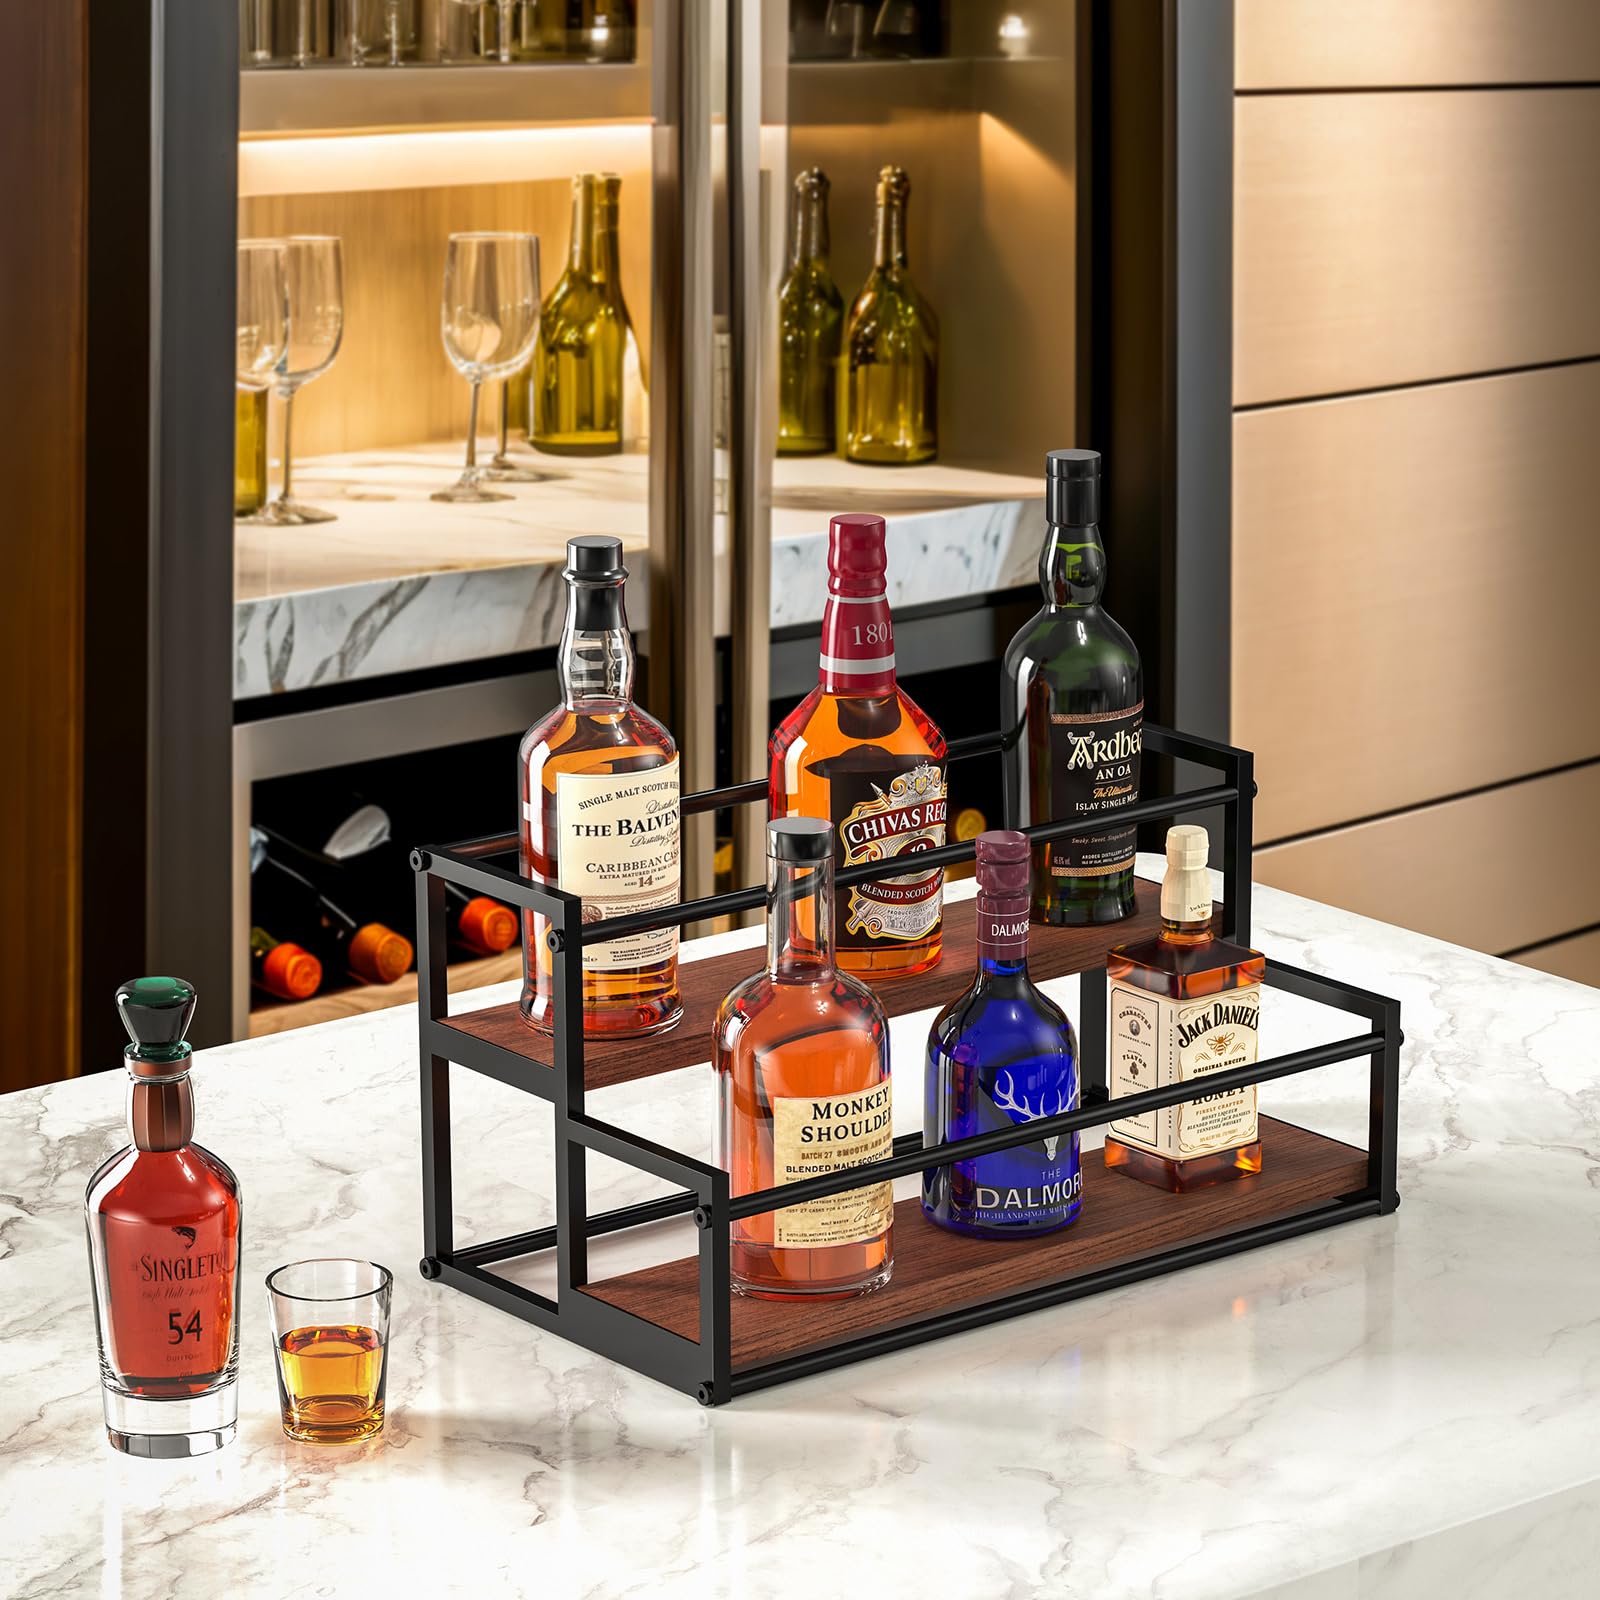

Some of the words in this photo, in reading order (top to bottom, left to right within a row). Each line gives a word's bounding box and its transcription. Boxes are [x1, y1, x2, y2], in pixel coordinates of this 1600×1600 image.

[1096, 767, 1114, 780] AN
[1117, 764, 1132, 777] OA
[578, 793, 613, 811] SINGLE
[615, 786, 640, 800] MALT
[642, 781, 669, 793] SCOTCH
[1076, 802, 1099, 811] ISLAY
[1101, 796, 1127, 809] SINGLE
[572, 824, 611, 837] THE
[848, 808, 921, 844] CHIVAS
[586, 855, 662, 873] CARIBBEAN
[638, 875, 653, 888] 14
[861, 883, 903, 899] BLENDED
[904, 883, 933, 899] SCOTCH
[1176, 1011, 1211, 1048] JACK
[1122, 1053, 1147, 1068] FLAVOR
[1192, 1062, 1222, 1074] ORIGINAL
[1223, 1056, 1247, 1069] RECIPE
[812, 1086, 889, 1121] MONKEY
[1217, 1099, 1244, 1110] CRAFTED
[801, 1152, 822, 1161] BATCH
[824, 1151, 833, 1160] 27
[837, 1143, 869, 1158] SMOOTH
[786, 1165, 831, 1173] BLENDED
[833, 1160, 856, 1172] MALT
[857, 1151, 883, 1166] SCOTCH
[1041, 1167, 1061, 1181] THE
[168, 1309, 203, 1345] 54
